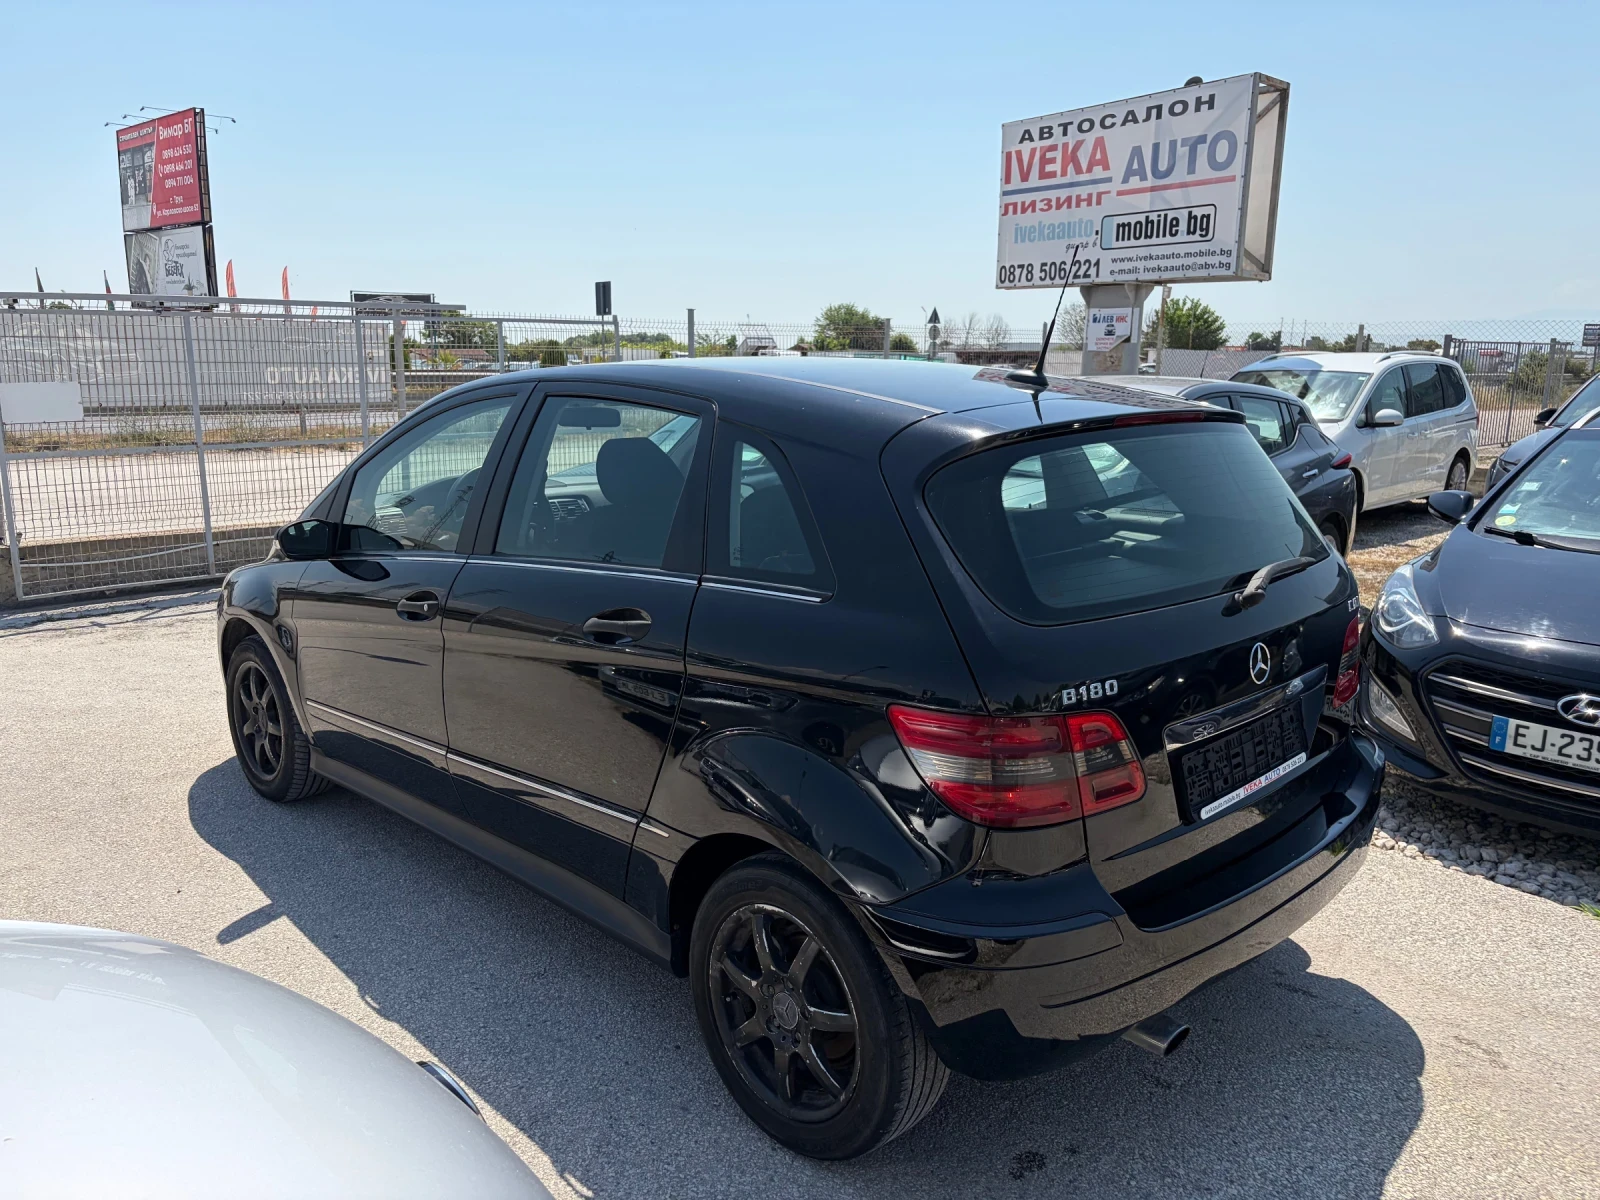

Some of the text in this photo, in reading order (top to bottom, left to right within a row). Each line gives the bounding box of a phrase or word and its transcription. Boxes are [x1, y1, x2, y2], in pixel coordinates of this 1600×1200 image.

[159, 117, 193, 140] Вимар БГ
[1018, 93, 1216, 145] АВТОСАЛОН
[1004, 130, 1238, 185] IVEKA AUTO
[1001, 190, 1112, 217] ЛИЗИНГ
[1115, 210, 1212, 243] mobile.bg
[1109, 260, 1231, 276] e-mail: ivekaauto@abv.bg
[1111, 248, 1232, 264] www.ivekaauto.mobile.bg
[999, 258, 1101, 284] 0878 506 221
[1495, 736, 1502, 744] F
[1243, 778, 1263, 794] IVEKA
[1264, 767, 1281, 782] AUTO
